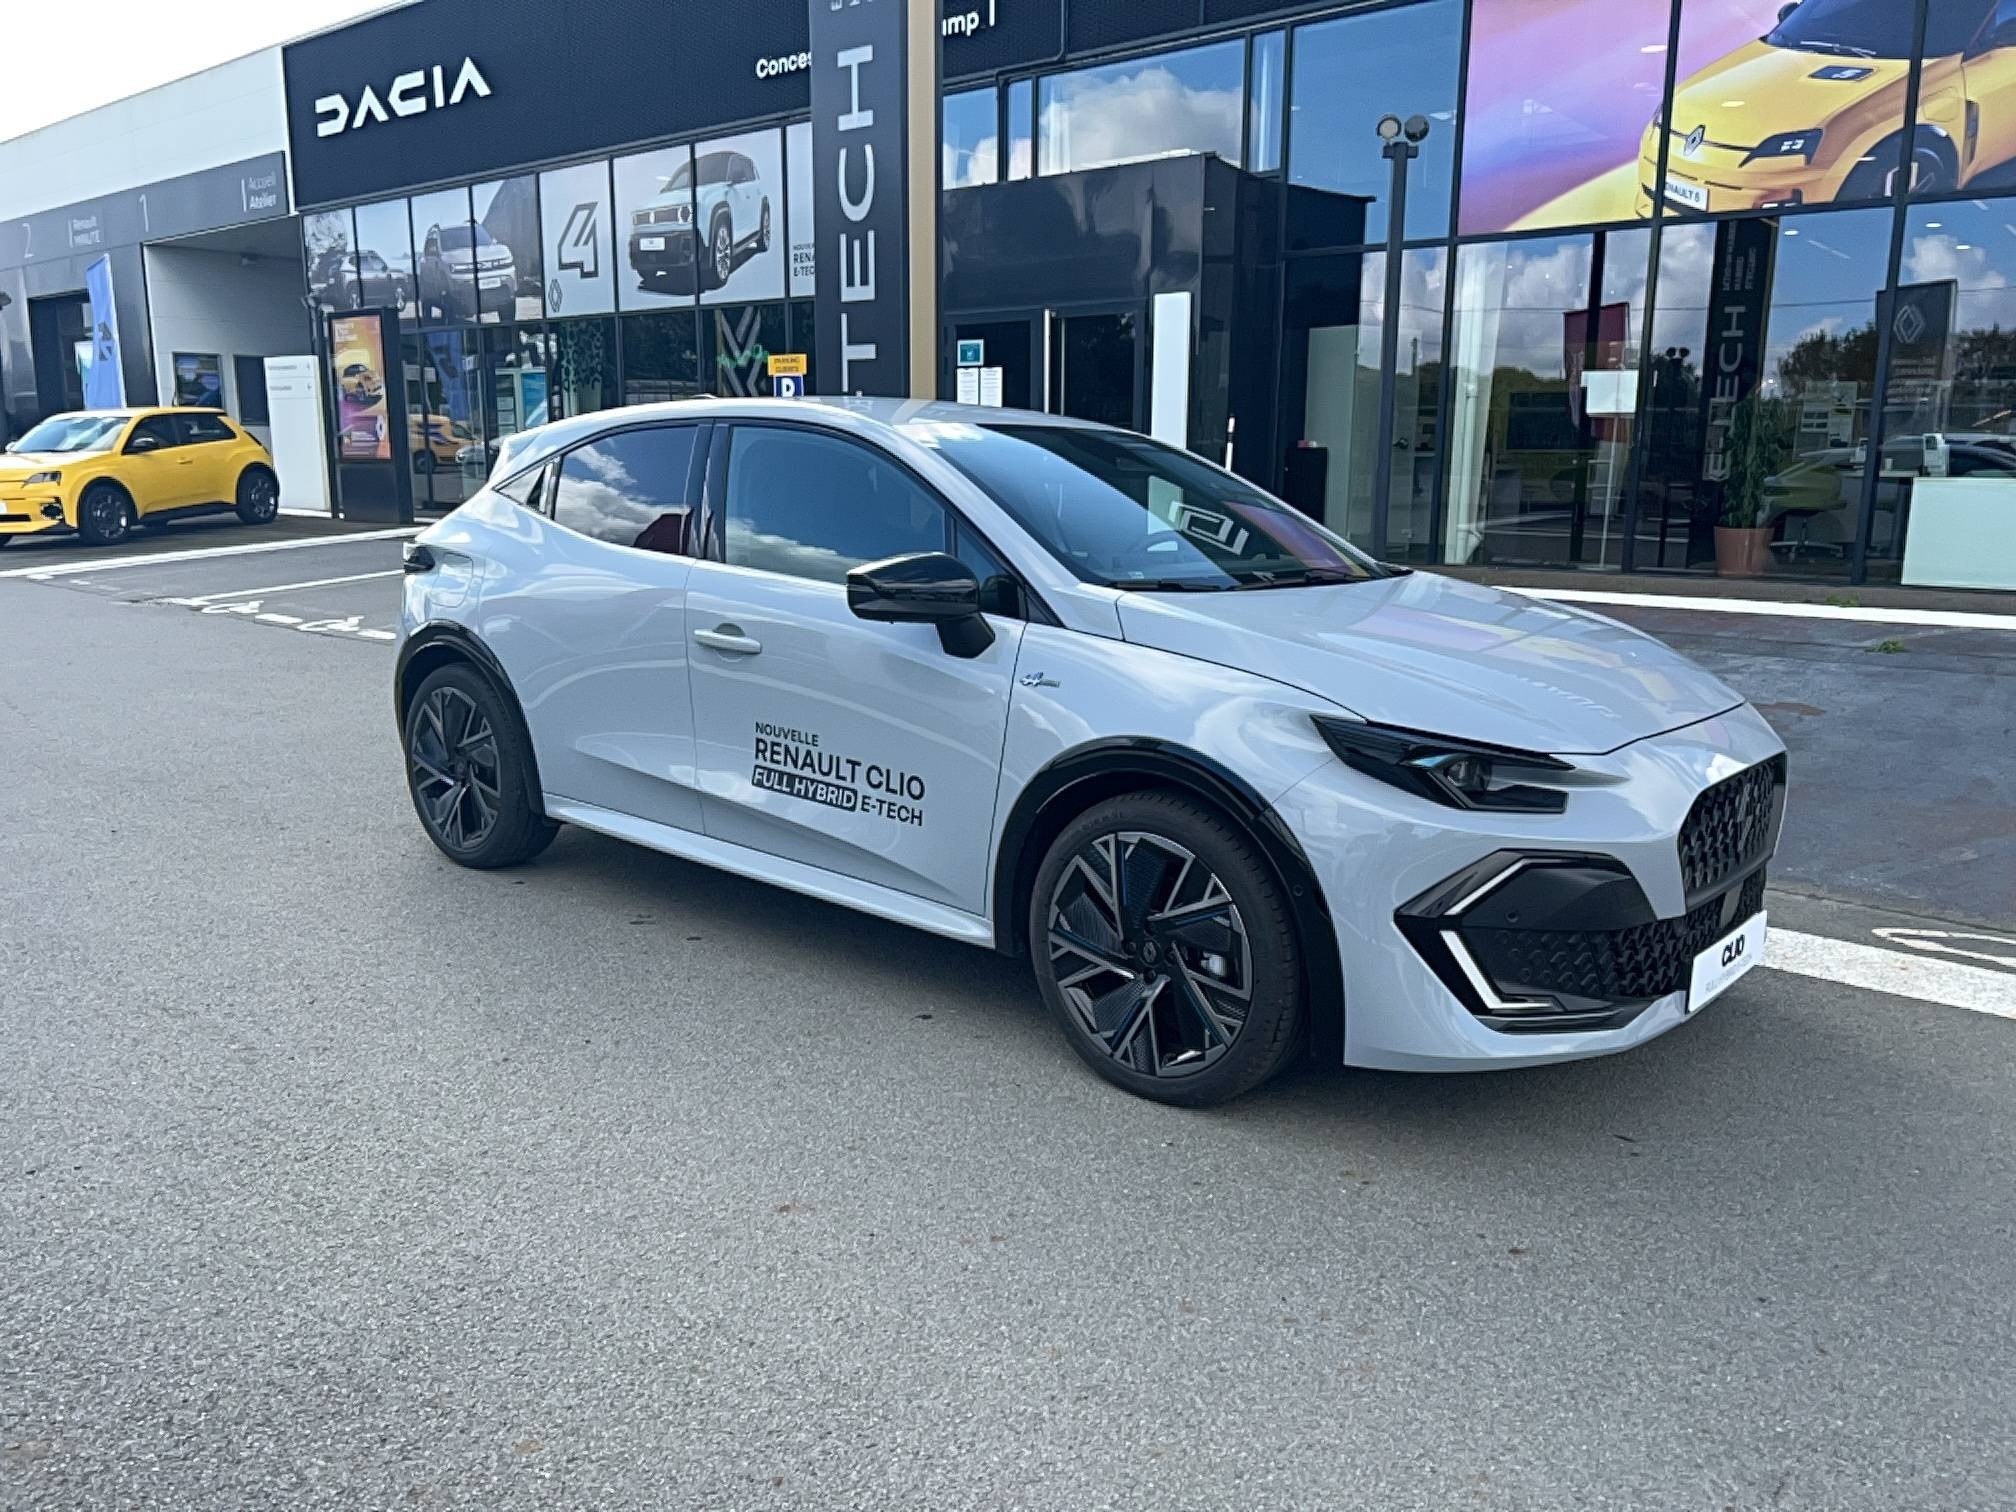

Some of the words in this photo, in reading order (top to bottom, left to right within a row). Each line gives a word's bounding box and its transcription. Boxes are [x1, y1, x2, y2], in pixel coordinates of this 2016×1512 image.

[314, 56, 492, 137] DACIA
[22, 223, 34, 258] 2
[558, 202, 599, 278] 4
[837, 45, 877, 397] TECH
[755, 721, 819, 747] NOUVELLE
[753, 768, 791, 792] FULL
[793, 781, 856, 807] HYBRID
[861, 795, 922, 827] E-TECH
[754, 737, 862, 783] RENAULT
[865, 765, 925, 801] CLIO
